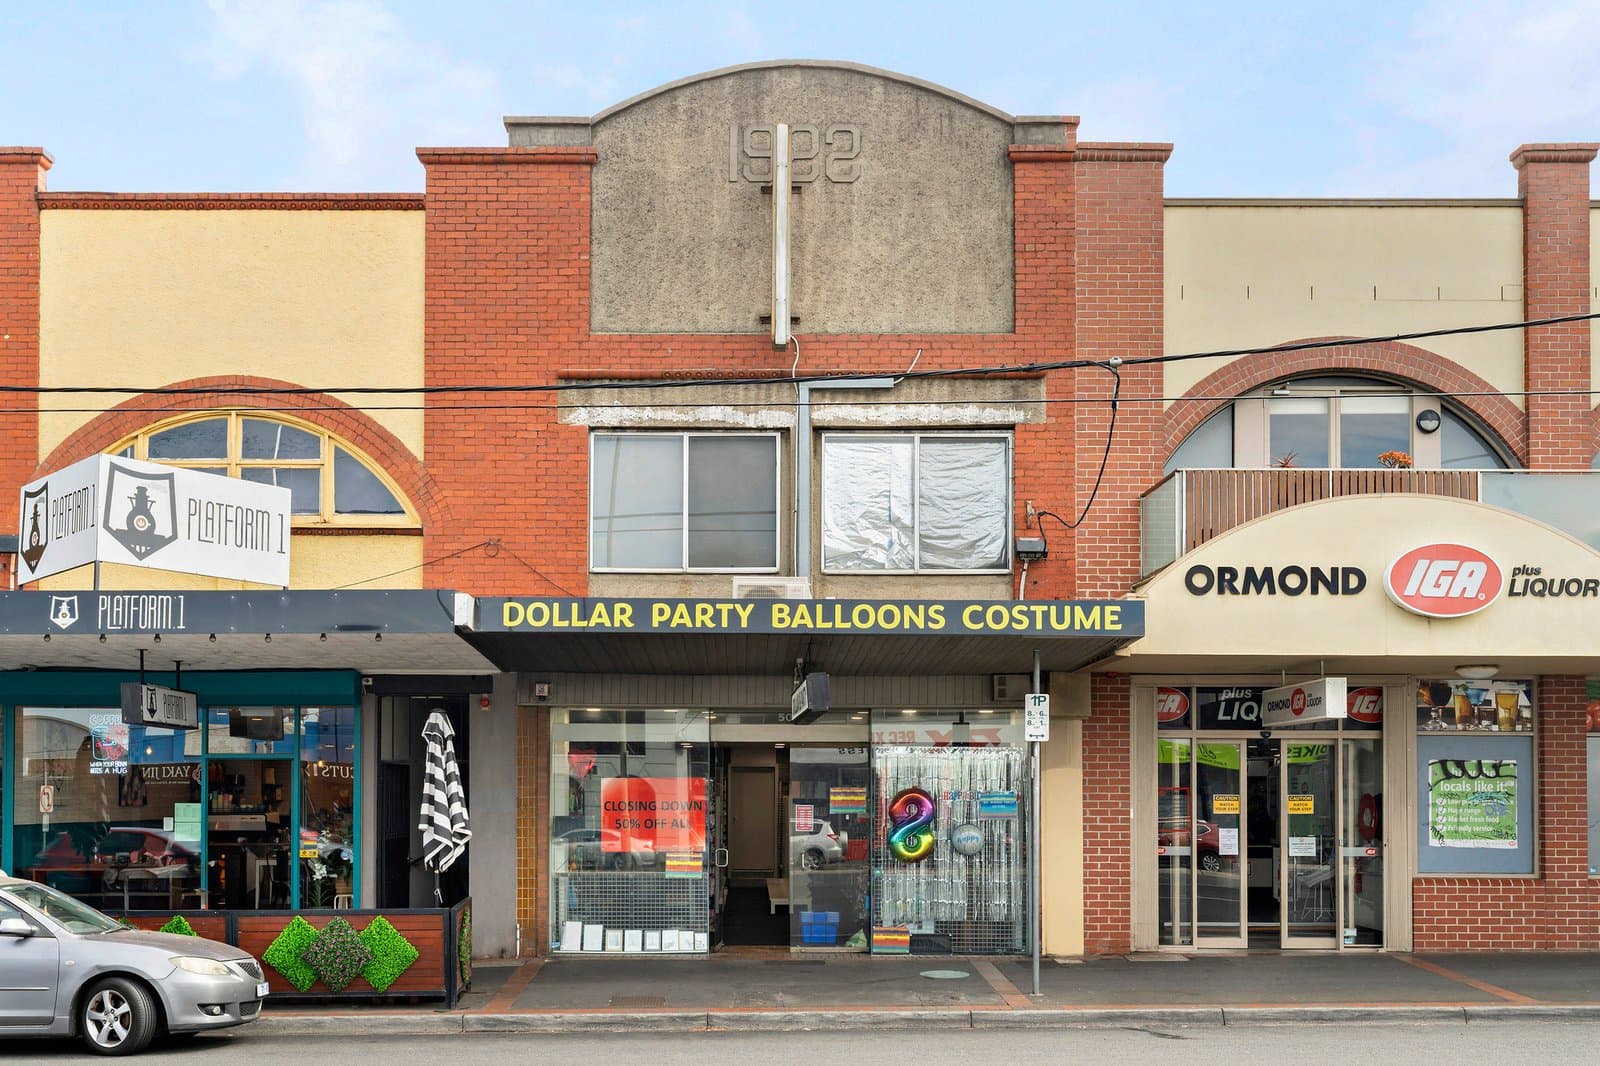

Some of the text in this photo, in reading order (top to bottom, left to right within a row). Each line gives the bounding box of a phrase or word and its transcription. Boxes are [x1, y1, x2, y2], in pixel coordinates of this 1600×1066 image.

[52, 484, 96, 540] PLATFORM 1
[188, 498, 286, 554] PLATFORM 1
[1184, 563, 1368, 596] ORMOND
[1404, 559, 1487, 599] IGA
[1511, 564, 1542, 578] plus
[1507, 577, 1600, 598] LIQUOR
[98, 595, 187, 630] PLATFORM 1
[502, 601, 1122, 631] DOLLAR PARTY BALLOONS COSTUME
[1031, 695, 1047, 706] 1P
[1221, 687, 1253, 701] plus
[1217, 701, 1262, 722] LIQ
[1267, 698, 1291, 713] ORMOND
[1440, 781, 1471, 791] locals
[1474, 781, 1494, 791] like
[604, 800, 703, 812] CLOSING DOWN
[615, 818, 640, 829] 50%
[644, 818, 667, 829] OFF
